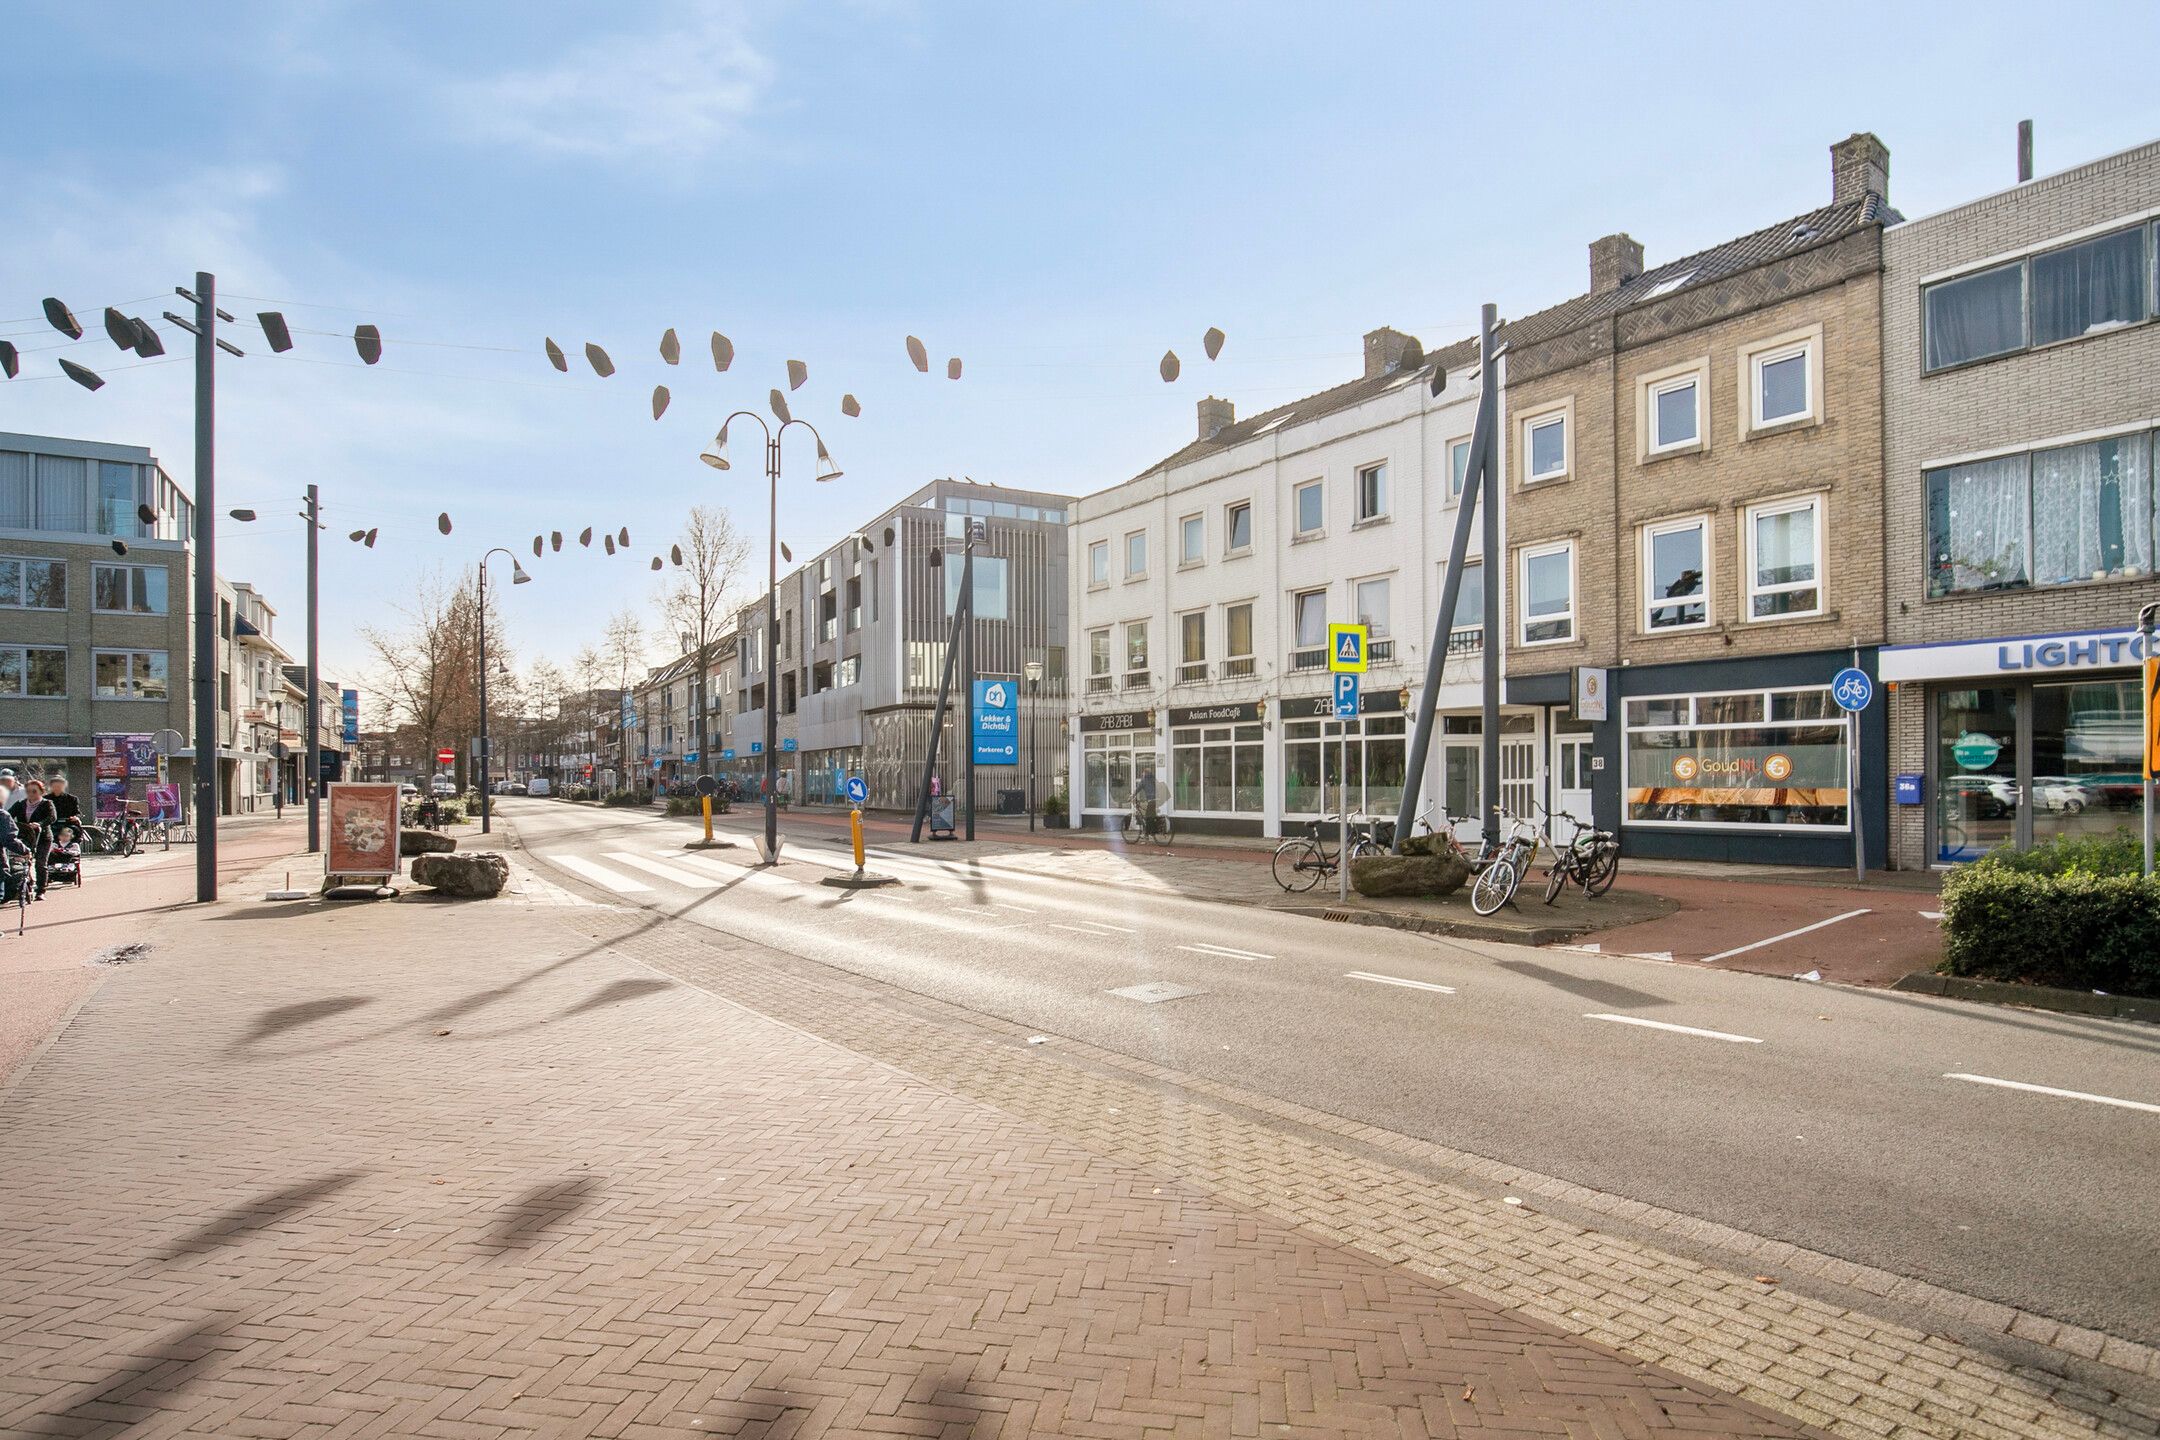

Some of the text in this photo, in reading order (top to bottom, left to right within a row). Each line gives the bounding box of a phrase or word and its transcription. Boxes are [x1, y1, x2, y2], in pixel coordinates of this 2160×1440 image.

[1340, 676, 1353, 699] P
[980, 714, 1011, 722] Lekker &
[1189, 710, 1207, 720] Asian
[982, 722, 1010, 731] Dichtbij
[1100, 716, 1114, 728] ZAB
[1593, 759, 1603, 768] 38
[1701, 757, 1760, 772] GoudNL
[1899, 782, 1916, 791] 36a
